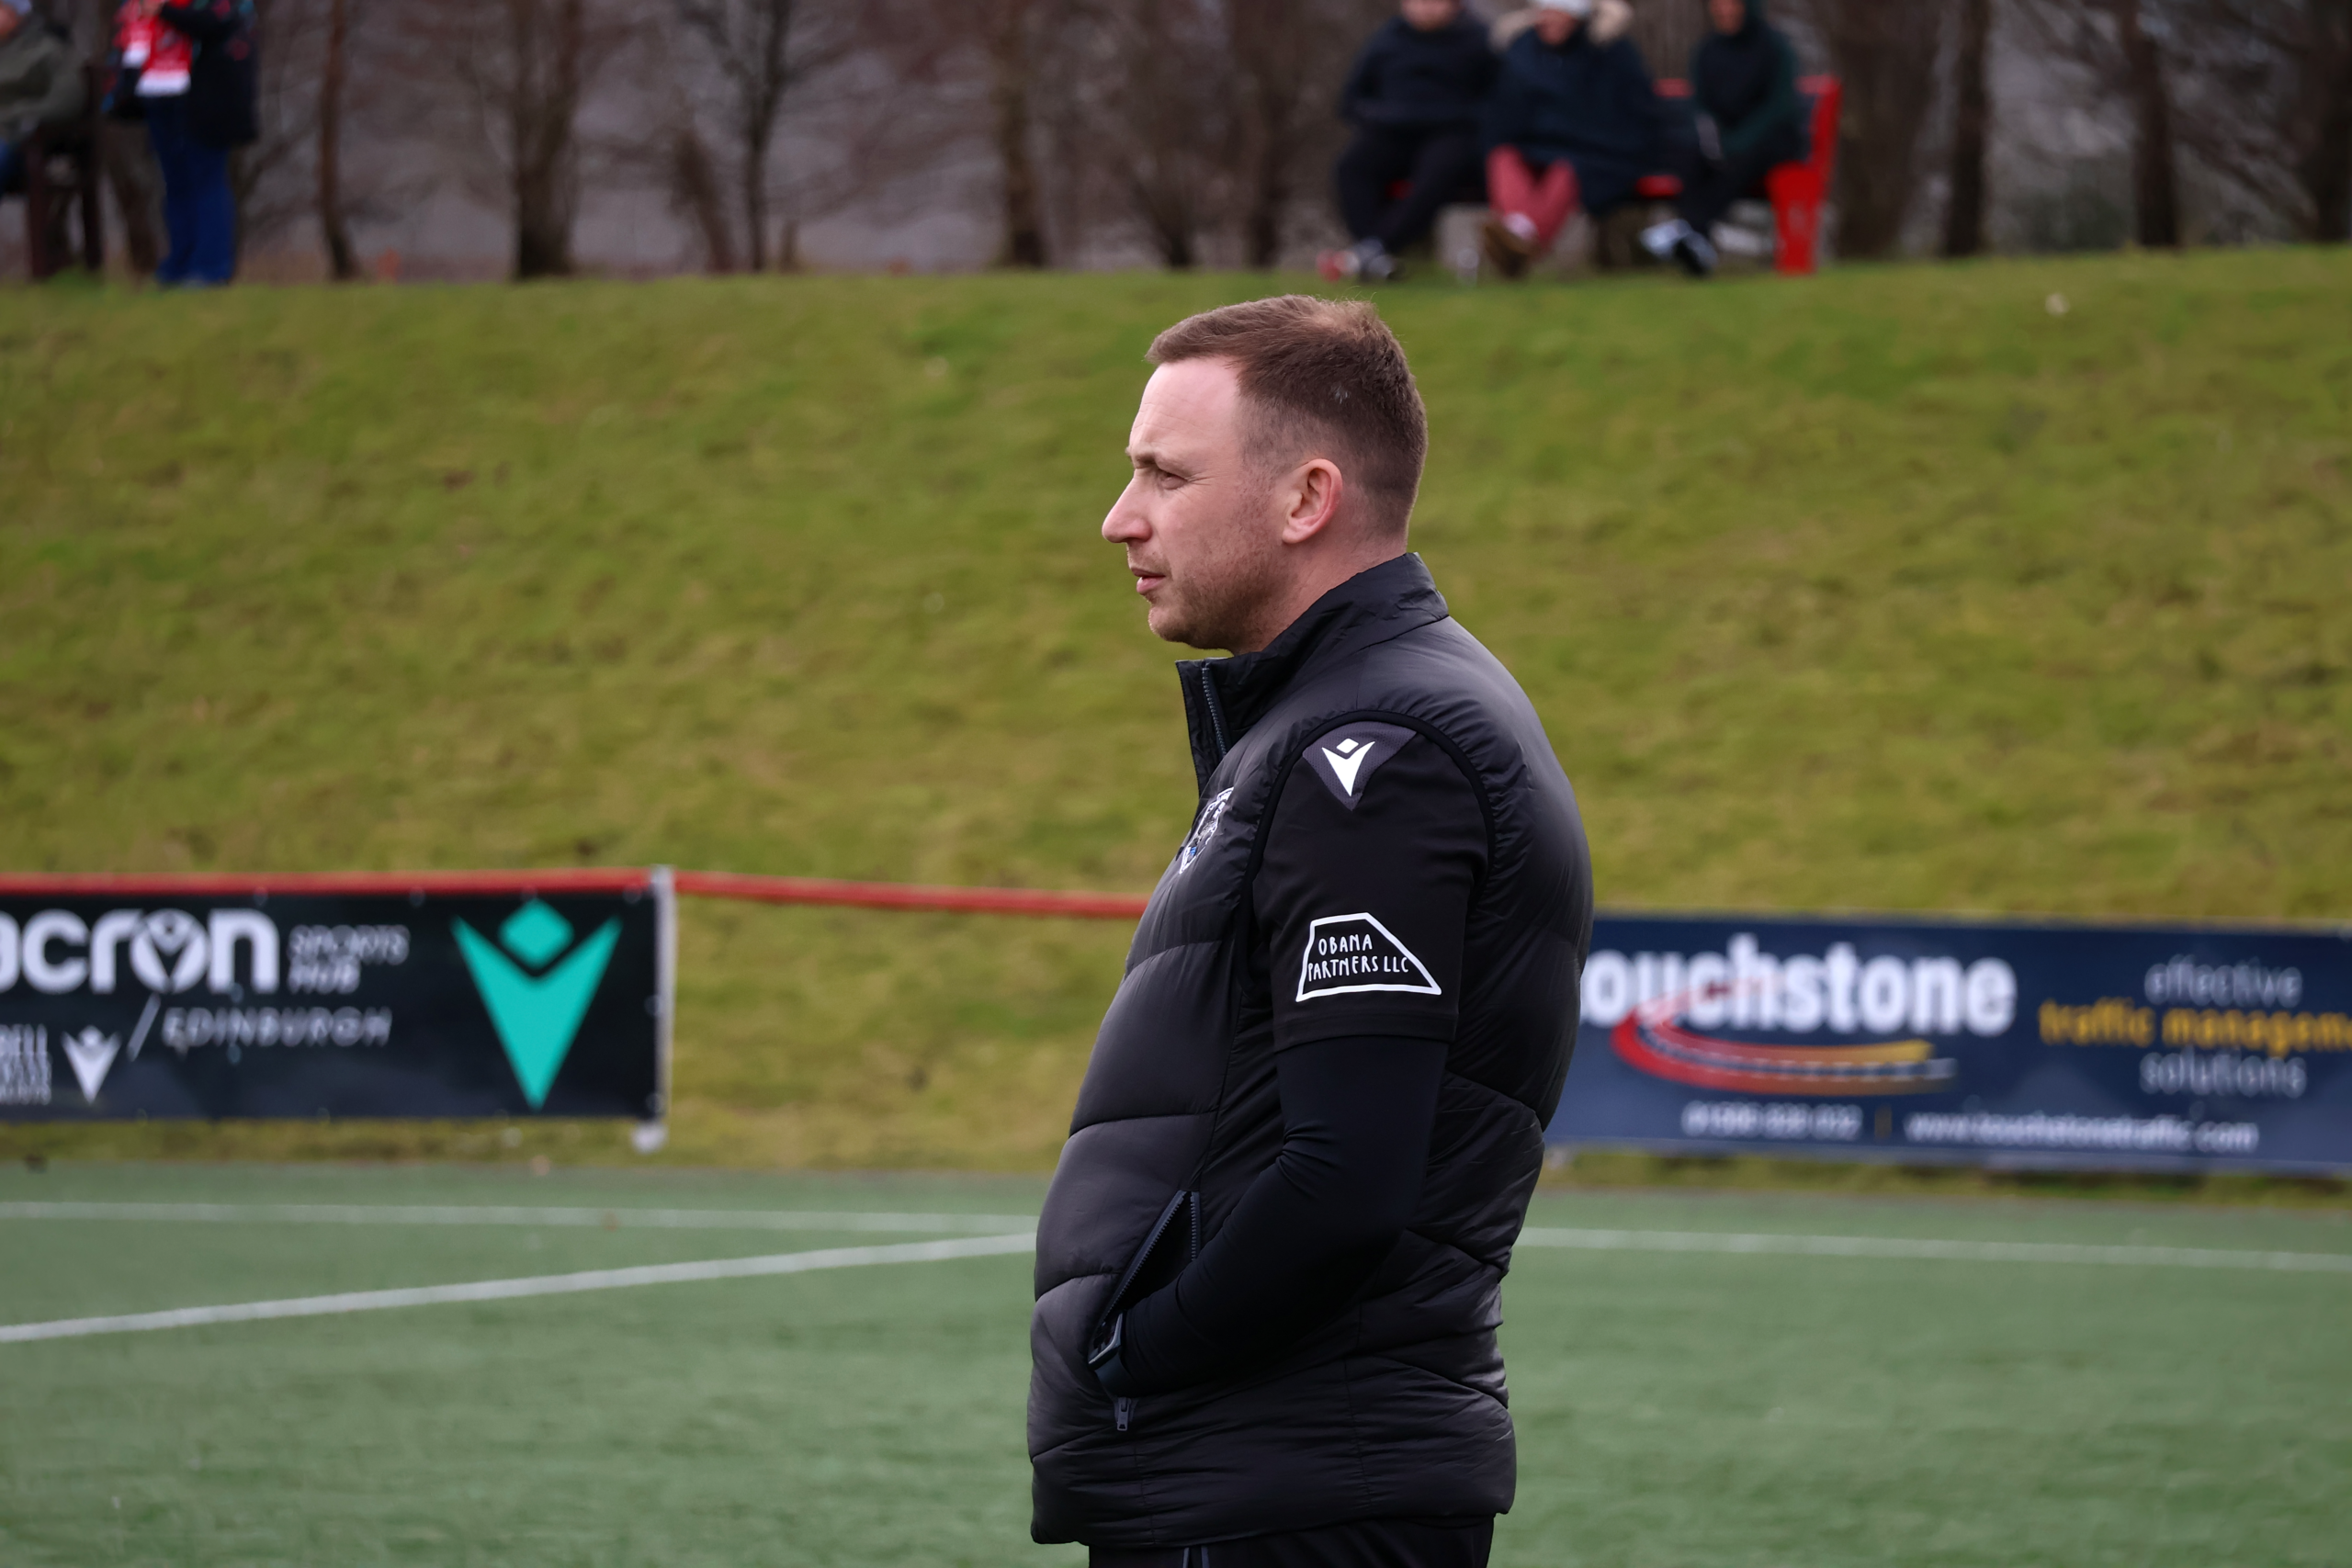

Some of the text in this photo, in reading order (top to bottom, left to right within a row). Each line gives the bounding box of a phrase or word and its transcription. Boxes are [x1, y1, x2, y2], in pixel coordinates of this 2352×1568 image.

[288, 926, 410, 964] SPORTS
[1308, 955, 1409, 982] PARTNERS LLC
[1318, 934, 1373, 955] OBANA
[1579, 932, 2018, 1038] ouchstone
[2143, 954, 2302, 1008] effective
[2038, 997, 2156, 1048] traffic
[2139, 1046, 2307, 1099] solutions
